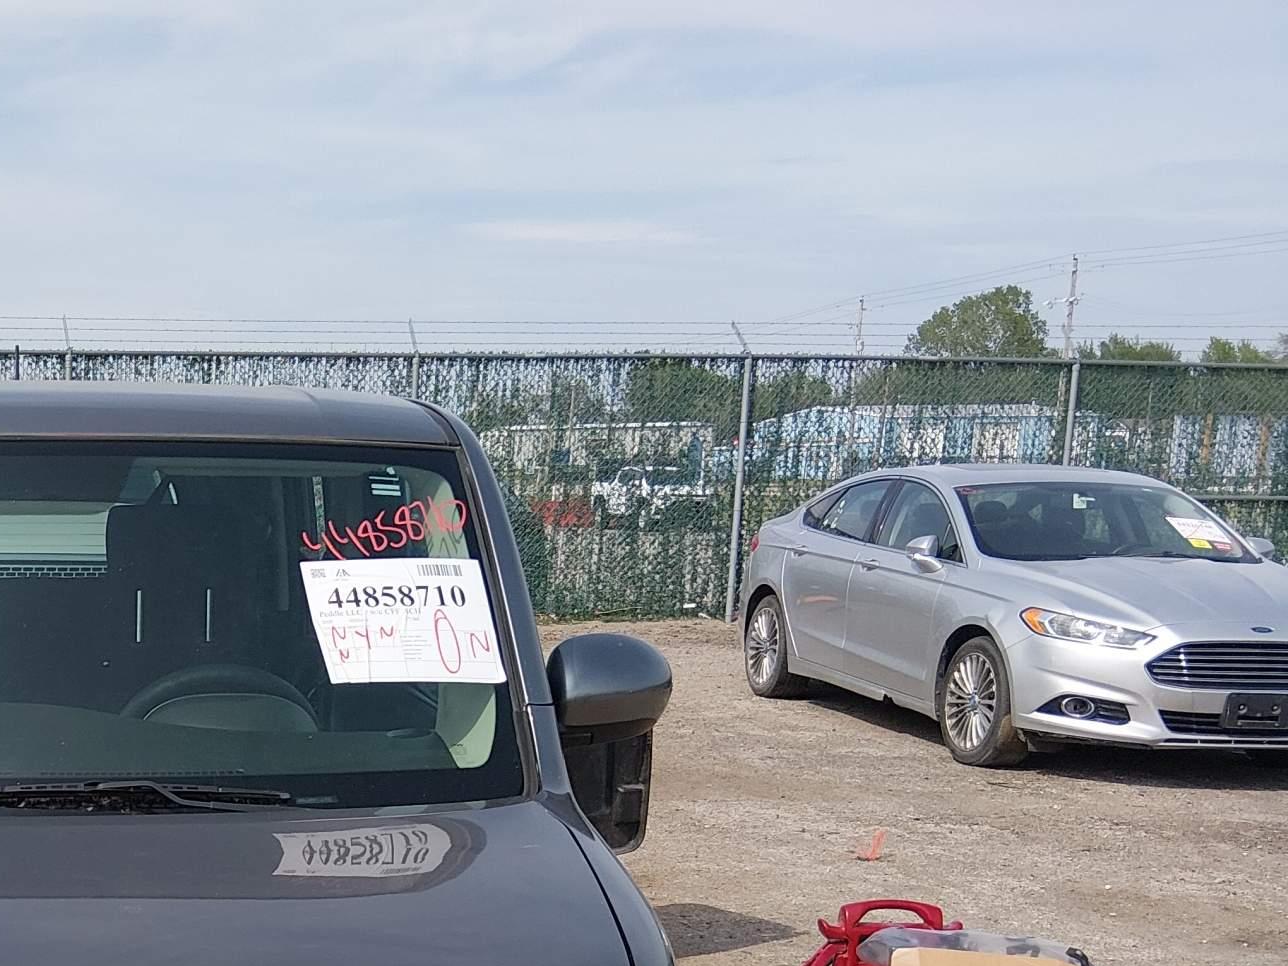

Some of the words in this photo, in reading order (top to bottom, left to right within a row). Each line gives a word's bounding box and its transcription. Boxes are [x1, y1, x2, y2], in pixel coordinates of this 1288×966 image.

[302, 496, 467, 560] 44858710
[327, 585, 466, 608] 44858710
[470, 631, 490, 658] N
